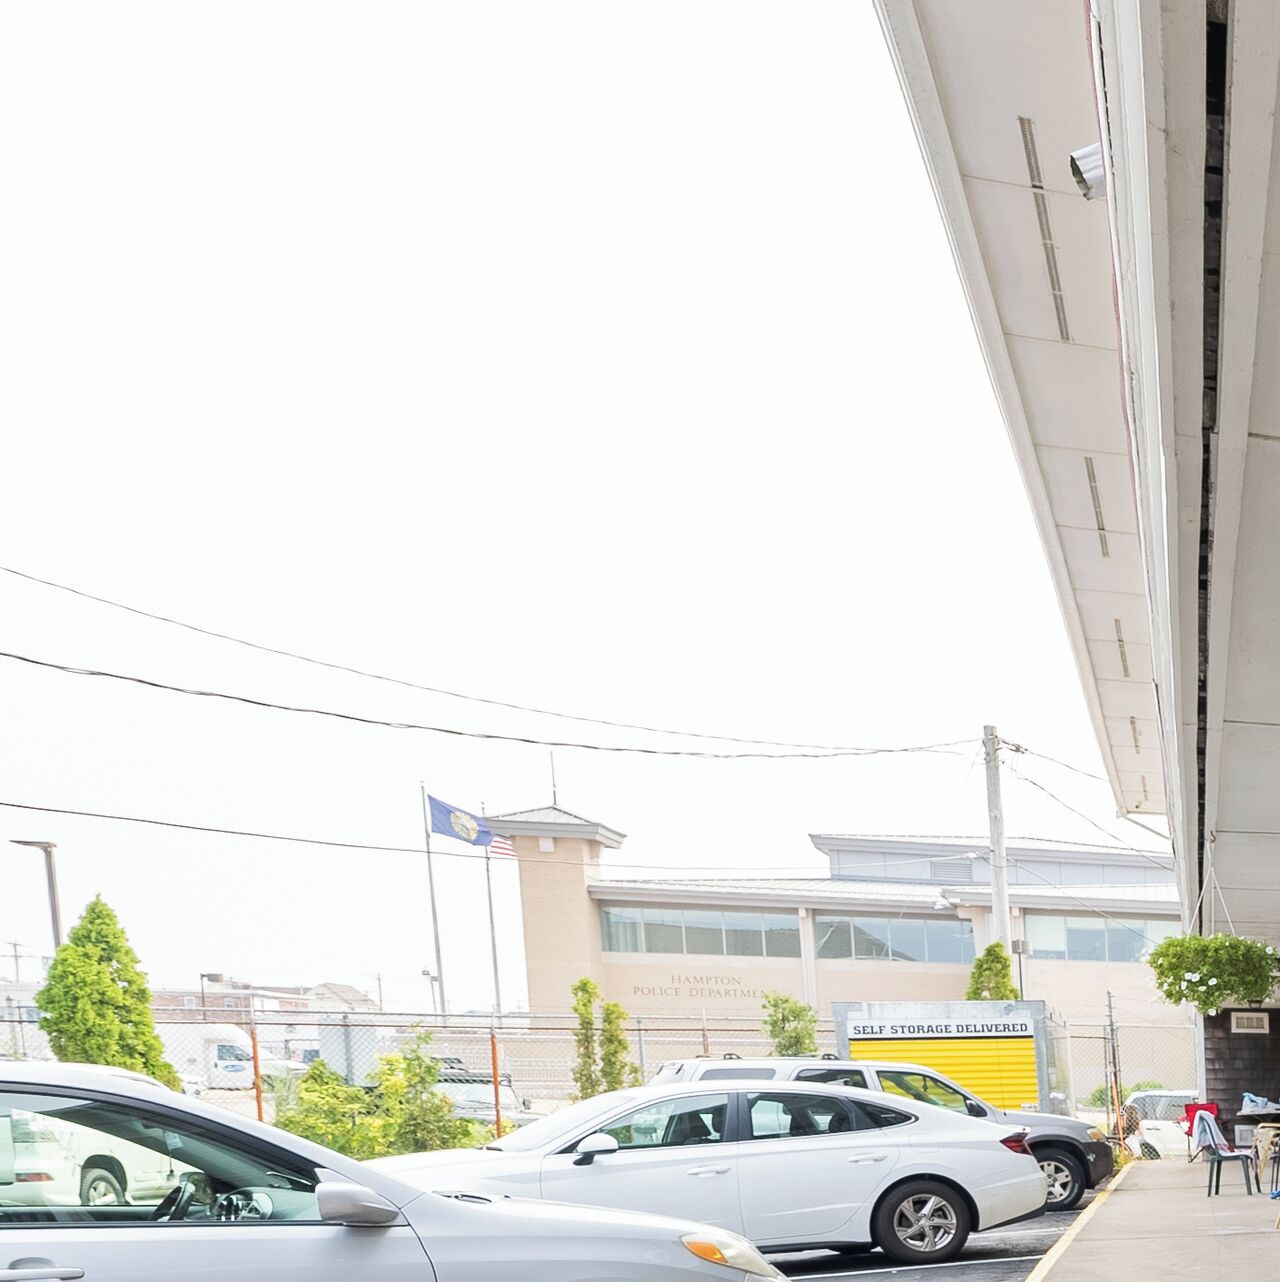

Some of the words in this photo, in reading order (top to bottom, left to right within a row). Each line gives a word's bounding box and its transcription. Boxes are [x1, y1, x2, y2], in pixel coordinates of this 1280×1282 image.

[671, 975, 742, 986] HAMPTON
[633, 986, 681, 997] POLICE
[853, 1024, 886, 1035] SELF
[890, 1024, 952, 1035] STORAGE
[956, 1022, 1028, 1034] DELIVERED
